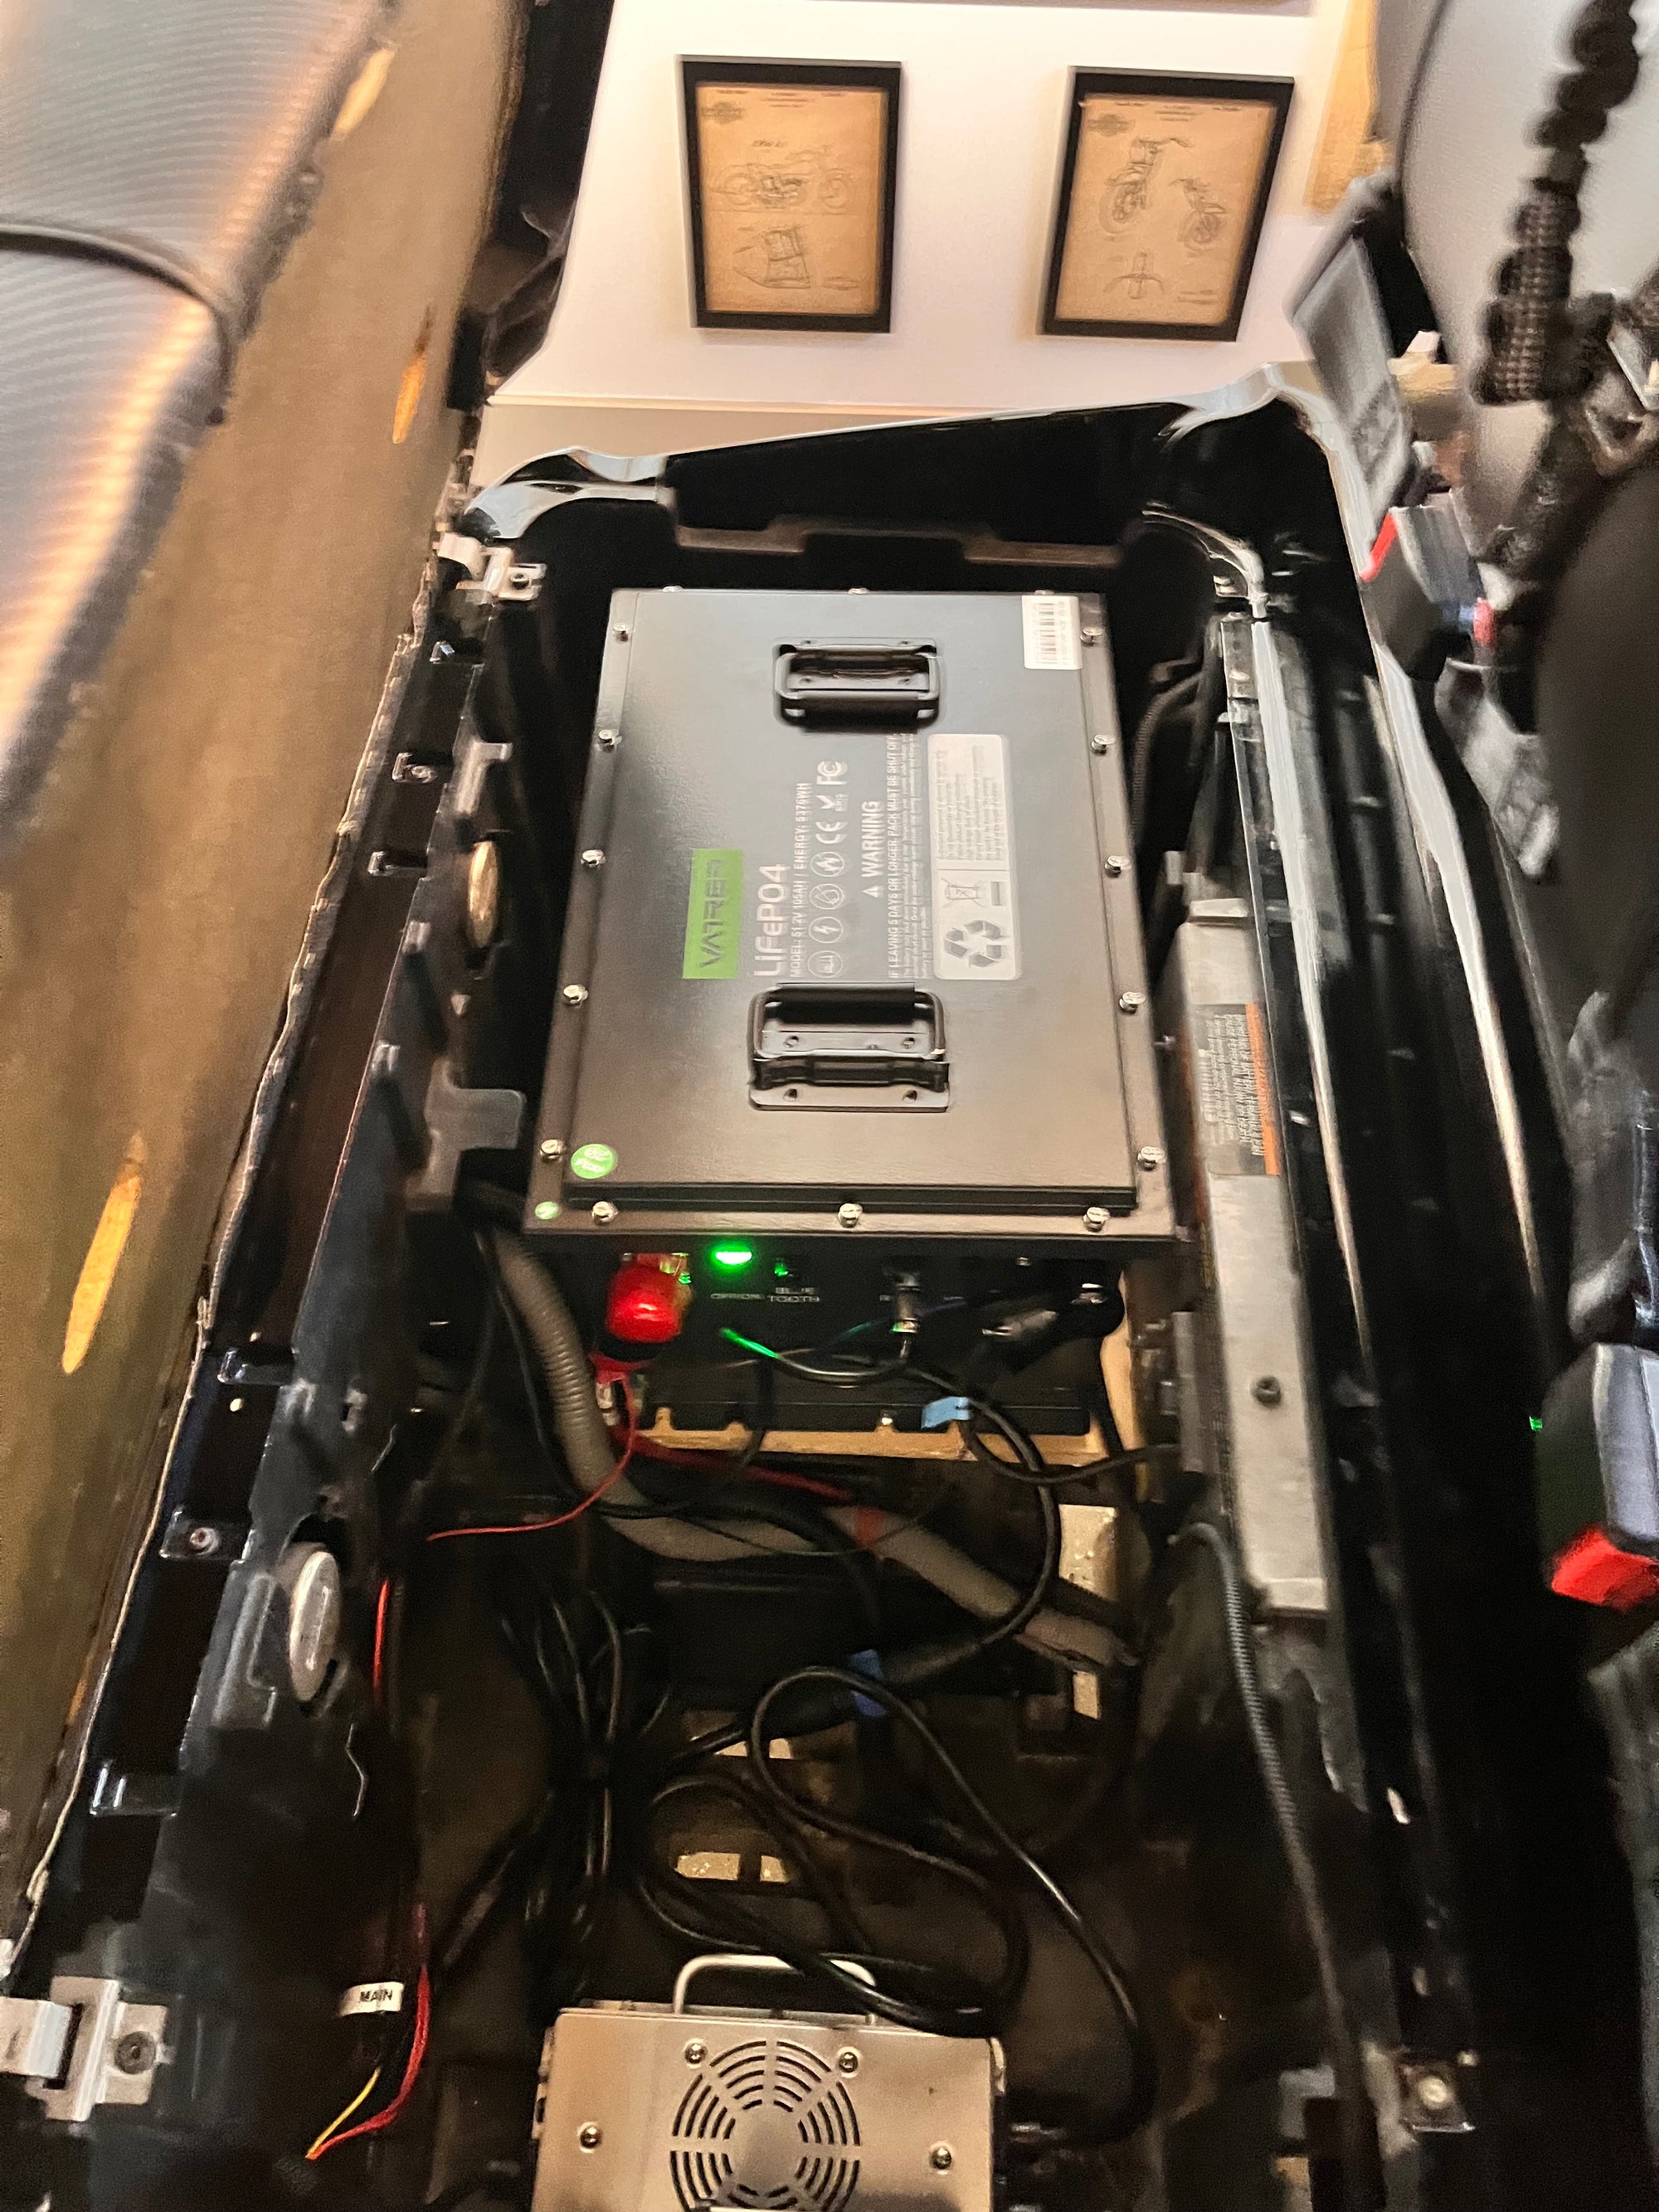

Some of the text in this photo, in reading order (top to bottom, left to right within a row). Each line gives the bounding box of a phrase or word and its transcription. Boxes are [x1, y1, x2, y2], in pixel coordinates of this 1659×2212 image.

[887, 752, 896, 773] SHUT
[887, 775, 896, 785] BE
[887, 787, 897, 811] MUST
[887, 813, 898, 836] PACK
[793, 824, 807, 870] ENERGY:
[861, 801, 882, 878] WARNING
[792, 881, 806, 909] 105AH
[888, 878, 898, 891] OR
[698, 858, 725, 967] VATRER
[888, 892, 898, 917] DAYS
[753, 863, 786, 977] LiFePO4
[791, 912, 803, 937] 51.2V
[789, 940, 802, 978] MODEL:
[888, 926, 898, 968] LEAVING
[888, 970, 898, 979] IF
[1228, 1038, 1243, 1076] PERSONAL
[360, 1989, 392, 2002] MAIN
